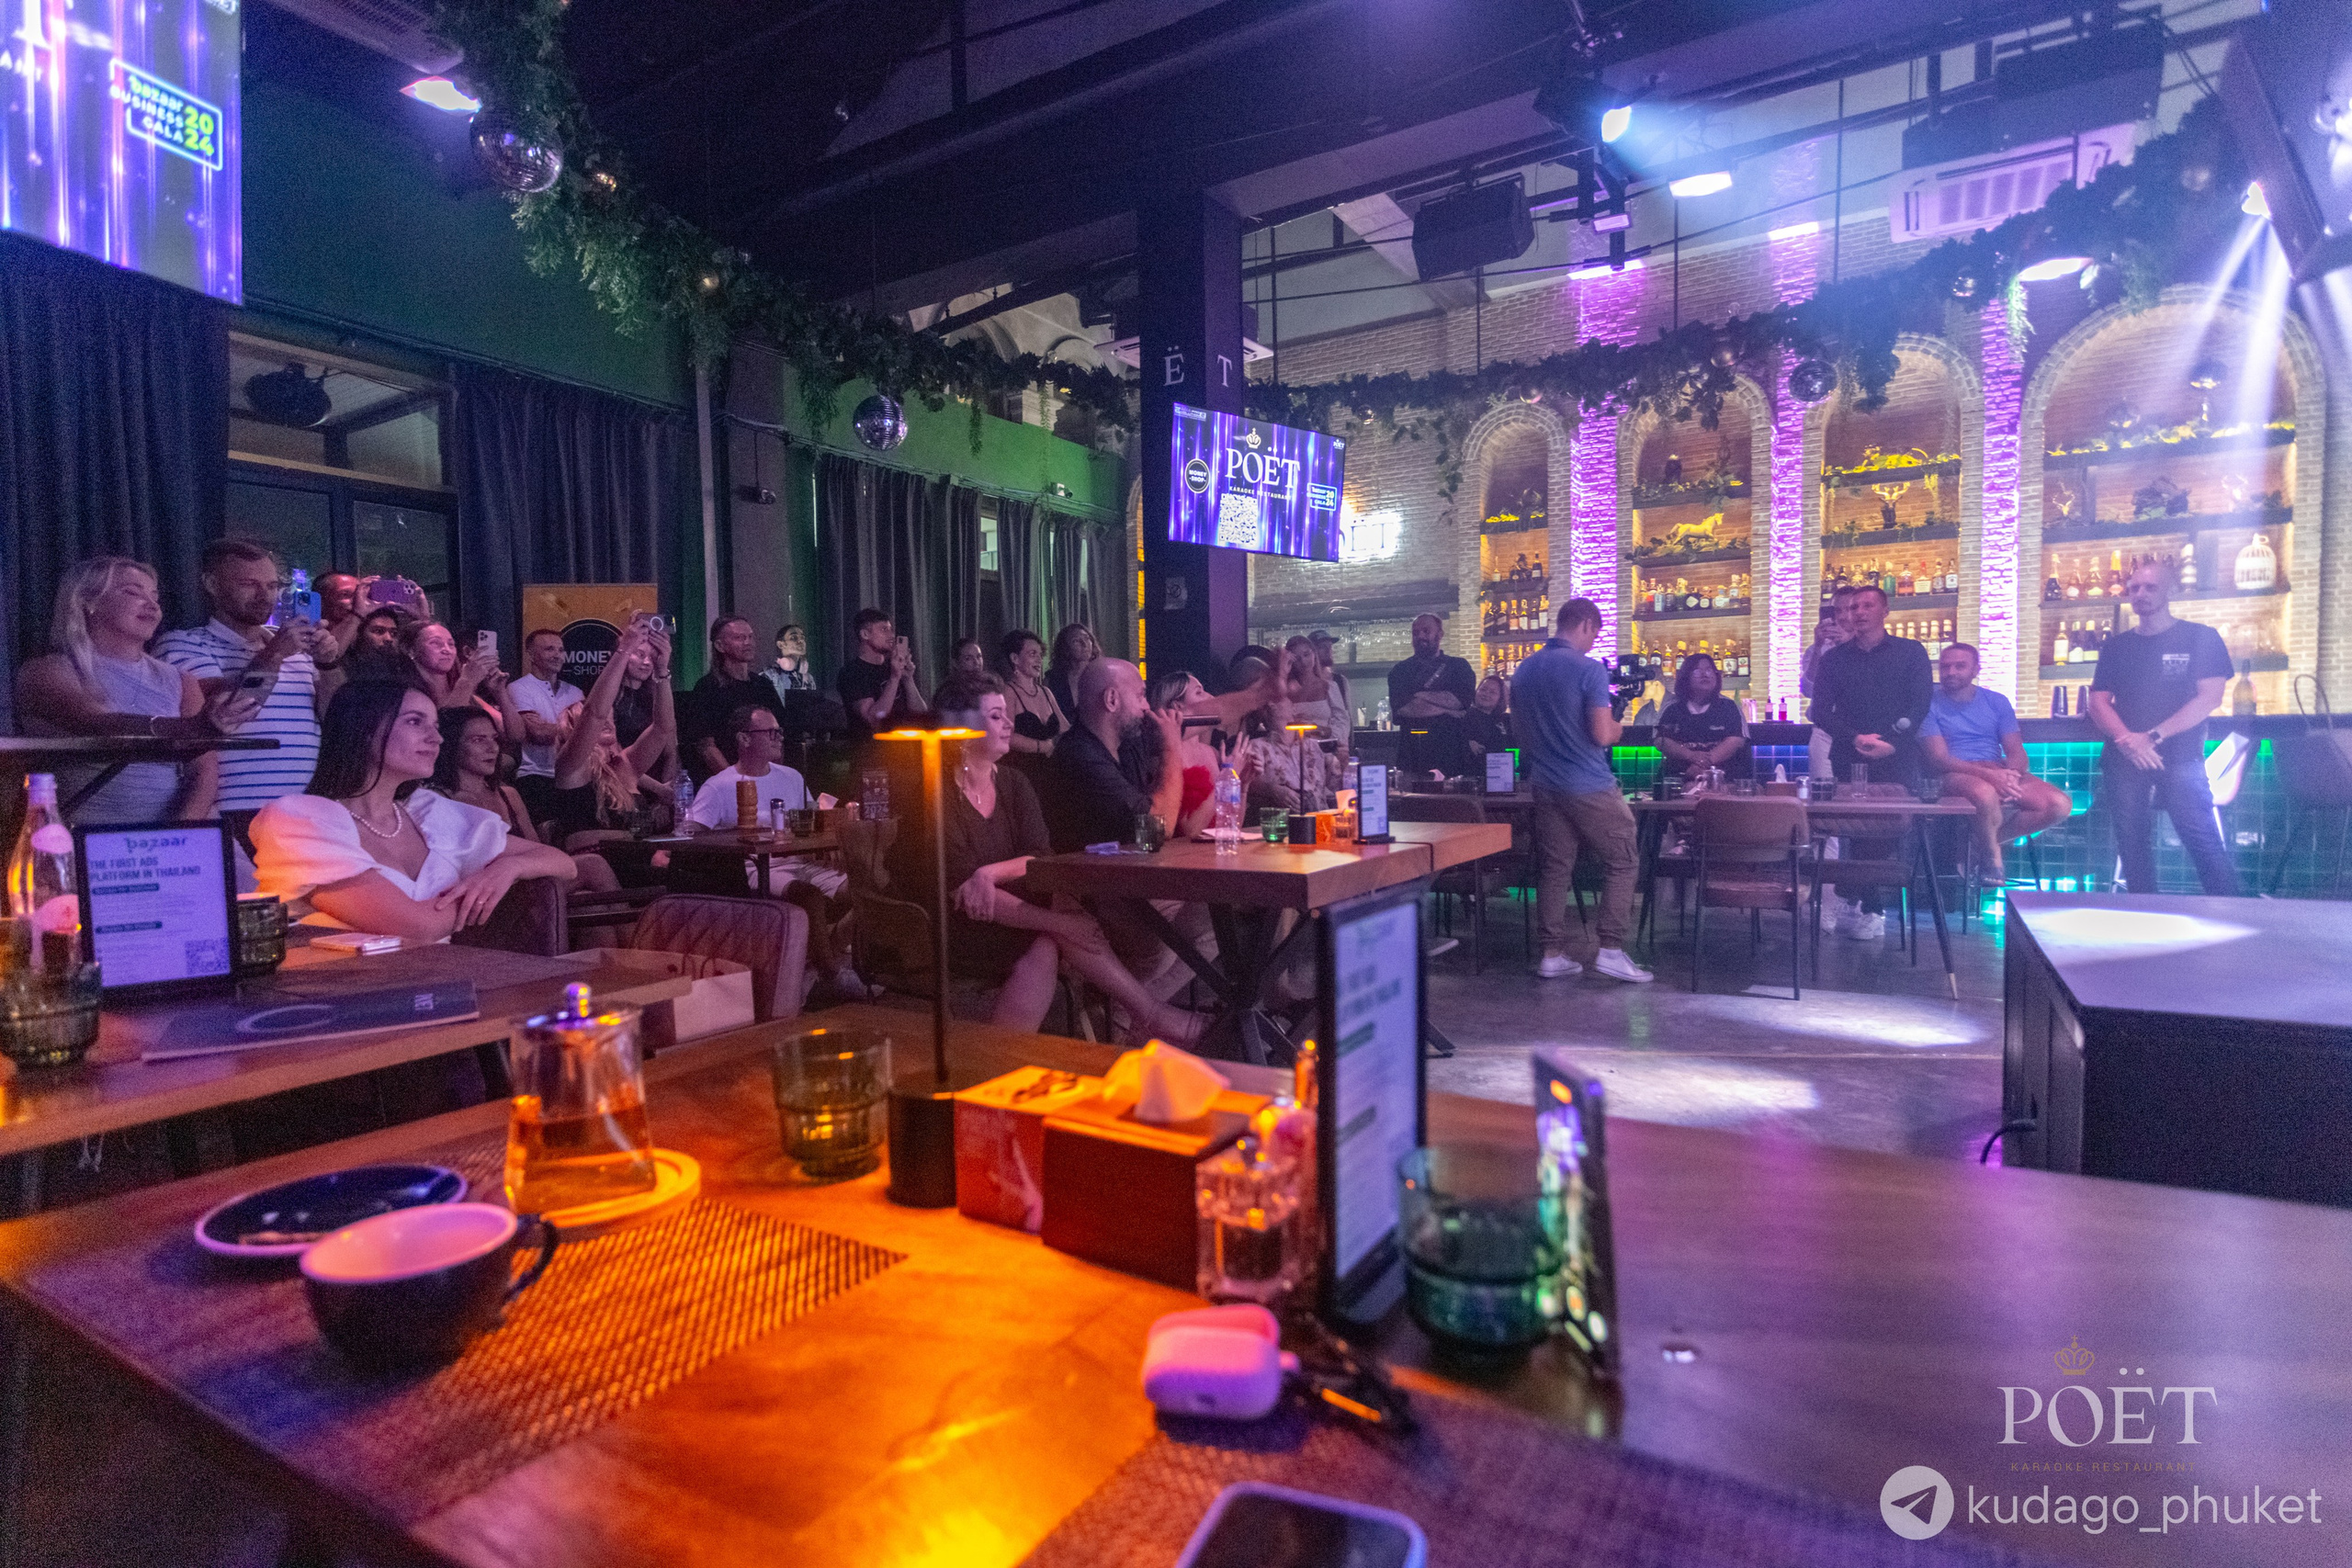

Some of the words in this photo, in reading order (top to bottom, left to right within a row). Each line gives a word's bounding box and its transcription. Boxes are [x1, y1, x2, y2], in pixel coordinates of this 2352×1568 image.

[109, 85, 184, 129] BUSINESS
[185, 106, 214, 135] 20
[142, 116, 184, 143] GALA
[185, 128, 214, 156] 24
[1225, 446, 1300, 489] POËT
[90, 871, 140, 882] PLATFORM
[155, 865, 201, 877] THAILAND
